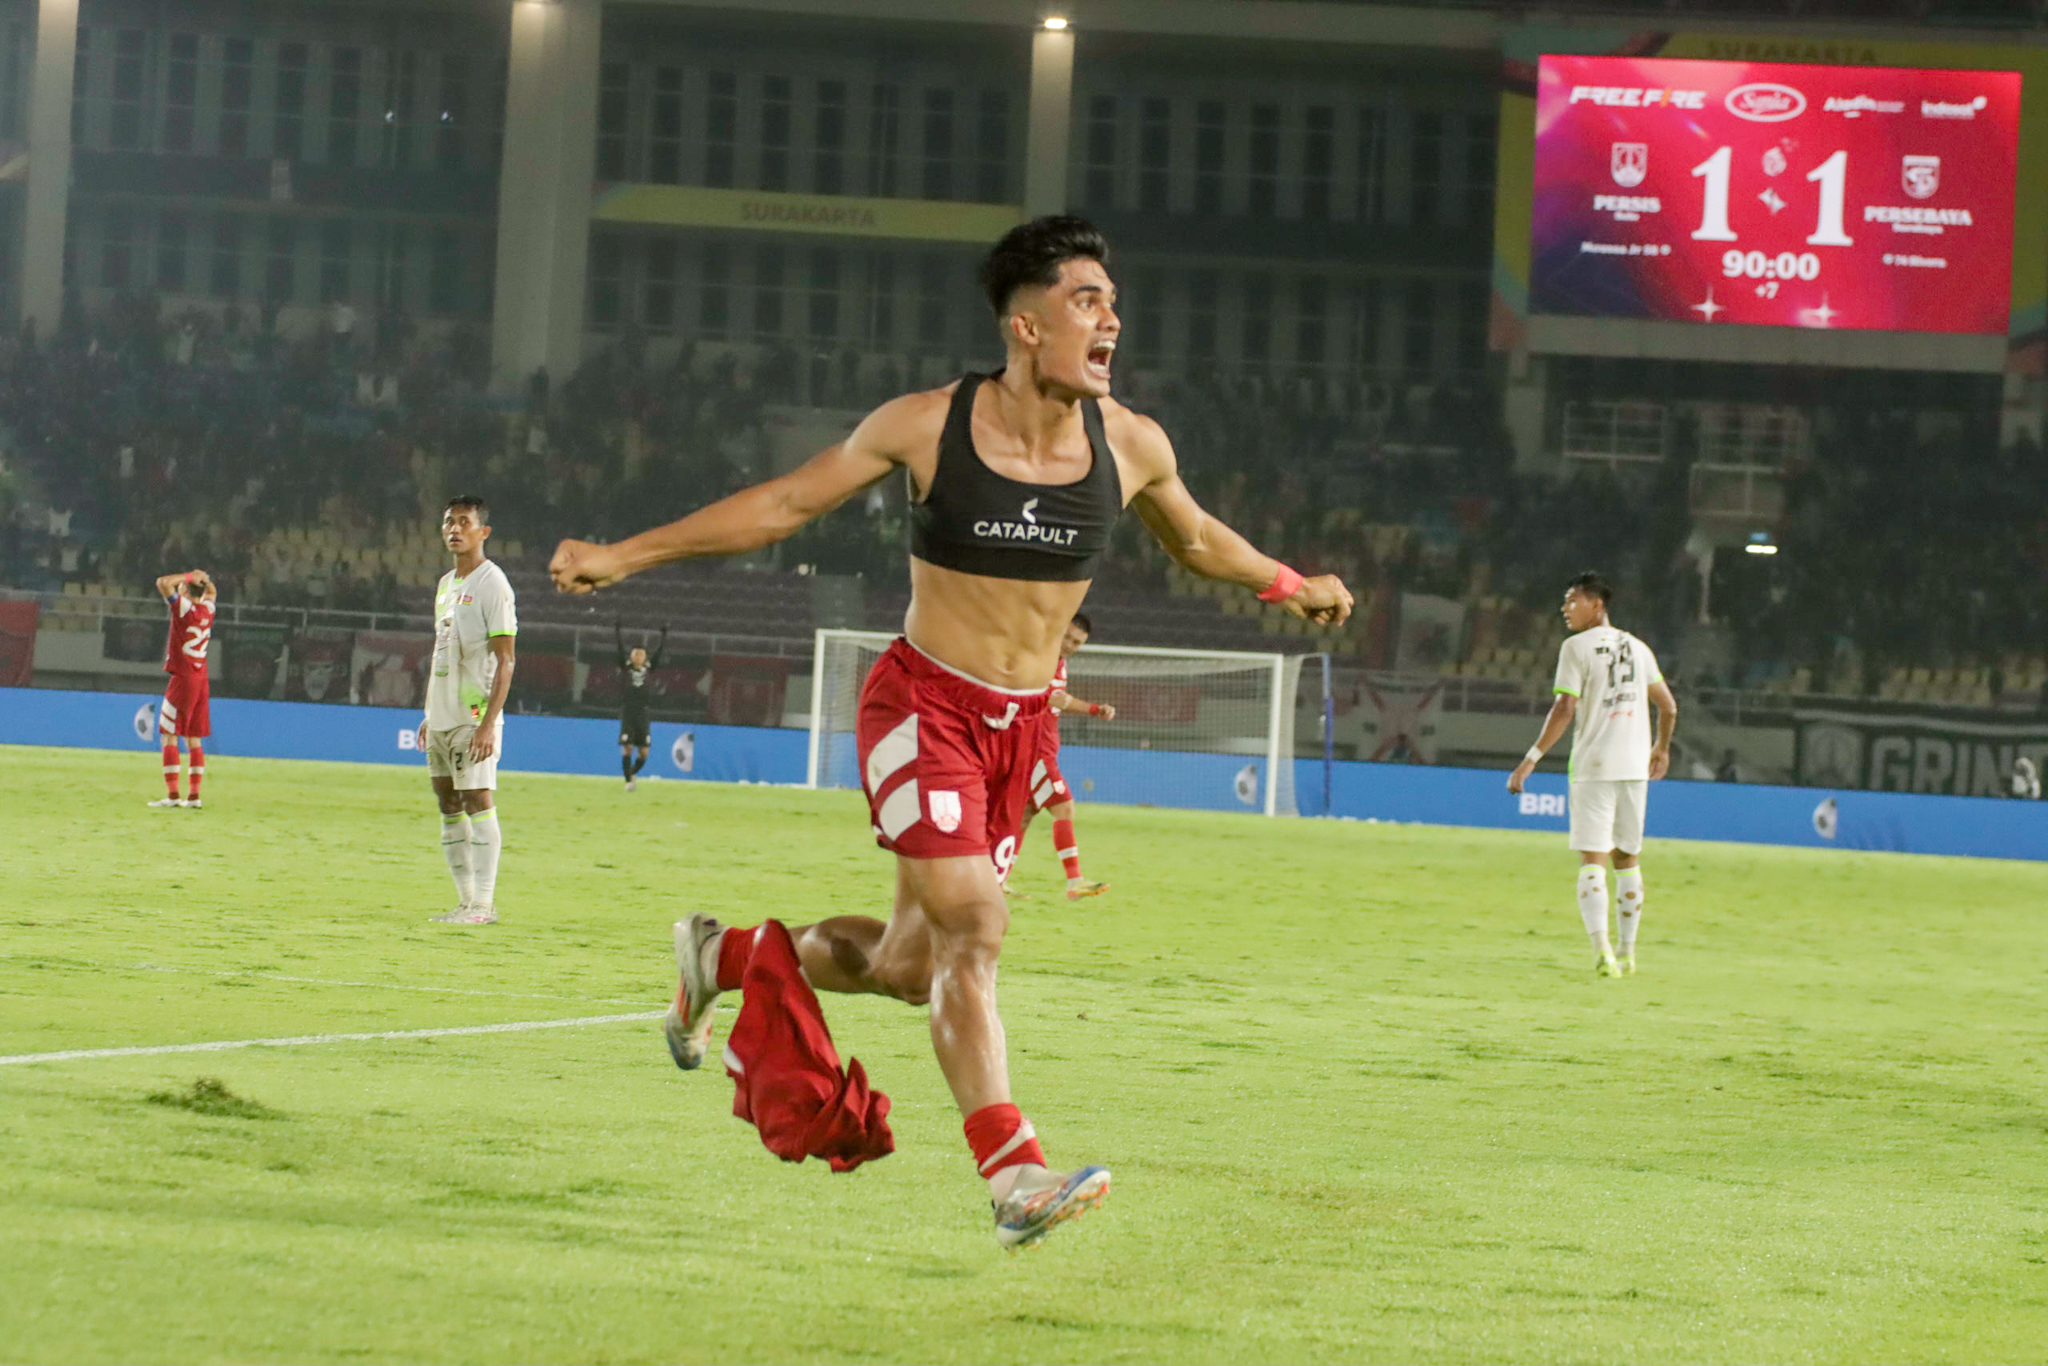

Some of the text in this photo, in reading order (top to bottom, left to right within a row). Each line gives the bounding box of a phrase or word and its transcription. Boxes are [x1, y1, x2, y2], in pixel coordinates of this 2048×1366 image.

[1570, 85, 1643, 107] FREE
[1593, 194, 1661, 213] PERSIS
[1691, 146, 1738, 242] 1
[1806, 150, 1853, 247] 1
[741, 202, 876, 227] SURAKARTA
[1864, 205, 1972, 226] PERSEBAYA
[1722, 249, 1820, 281] 90:00
[973, 520, 1078, 546] CATAPULT
[1519, 792, 1566, 817] BRI
[993, 834, 1016, 883] 9
